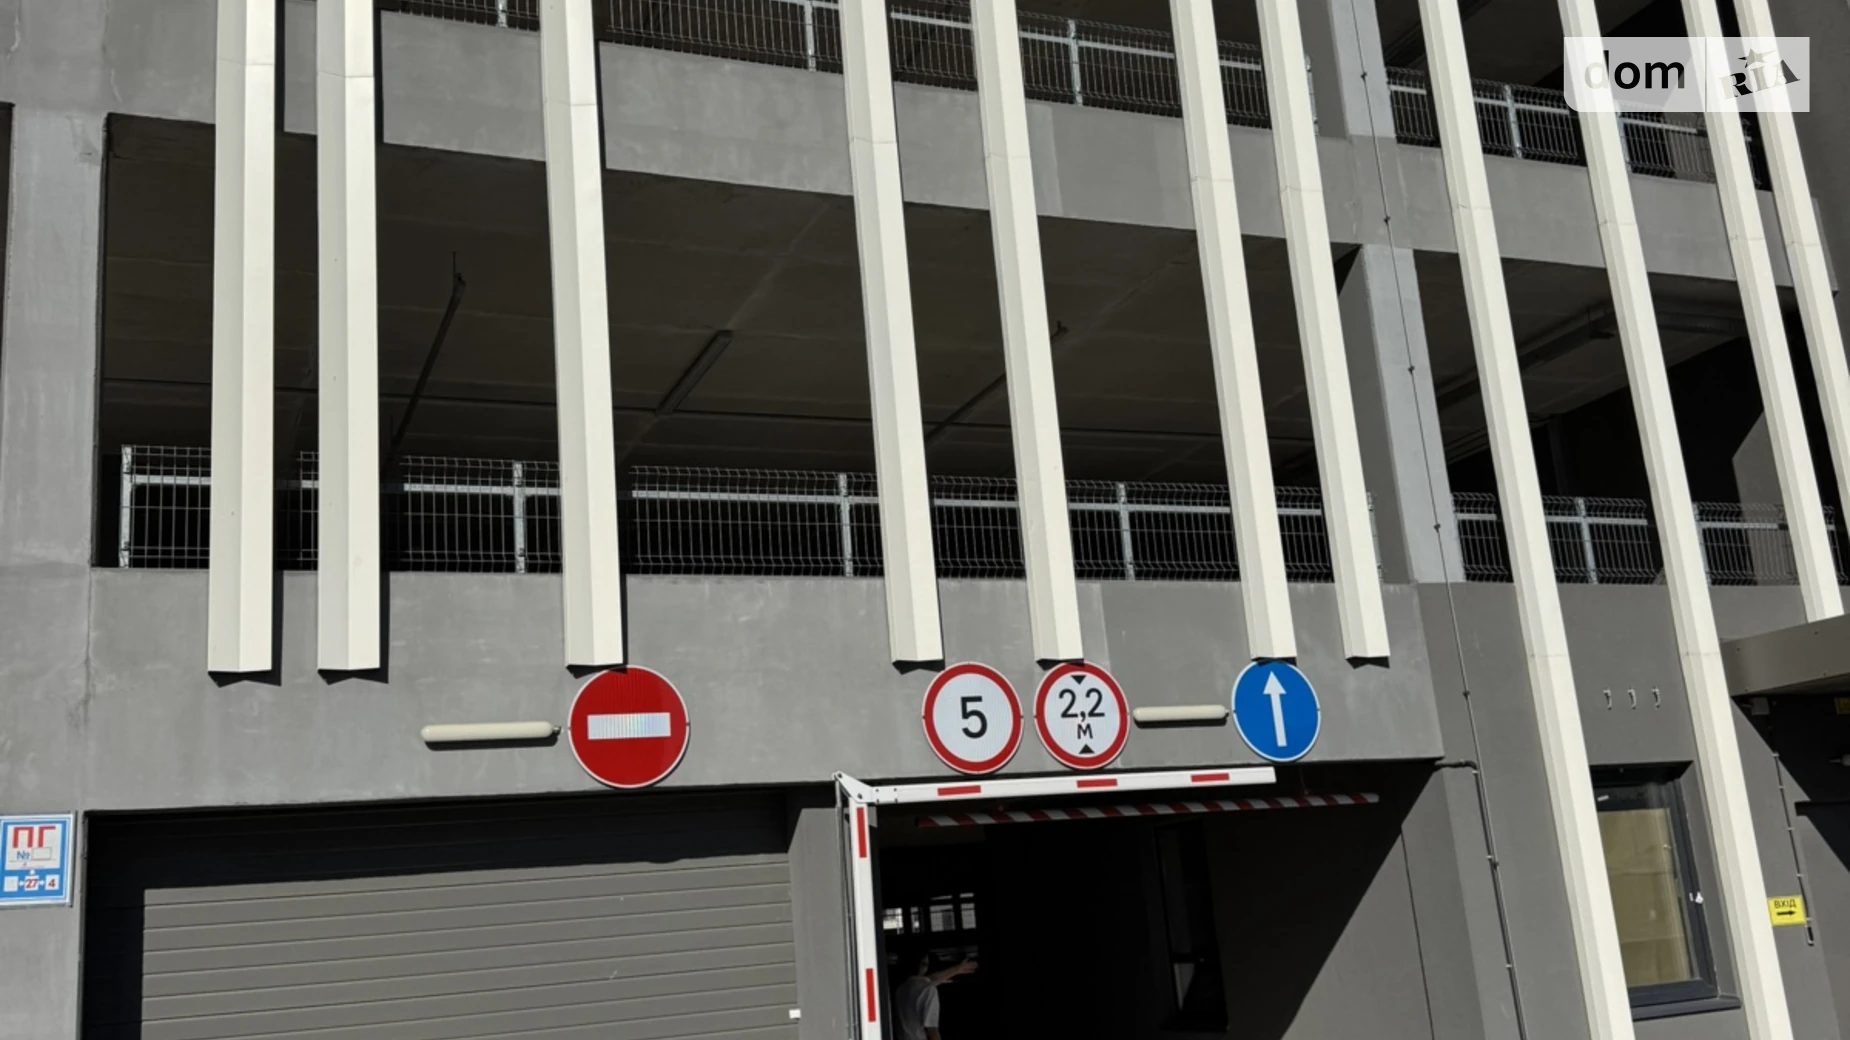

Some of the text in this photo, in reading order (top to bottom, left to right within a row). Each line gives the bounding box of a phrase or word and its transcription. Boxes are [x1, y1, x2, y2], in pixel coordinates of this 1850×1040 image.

[1058, 688, 1105, 722] 2,2
[960, 696, 988, 739] 5
[12, 825, 56, 848] ПГ
[25, 878, 38, 888] 27
[48, 878, 56, 888] 4
[1774, 899, 1797, 908] ВХІД
